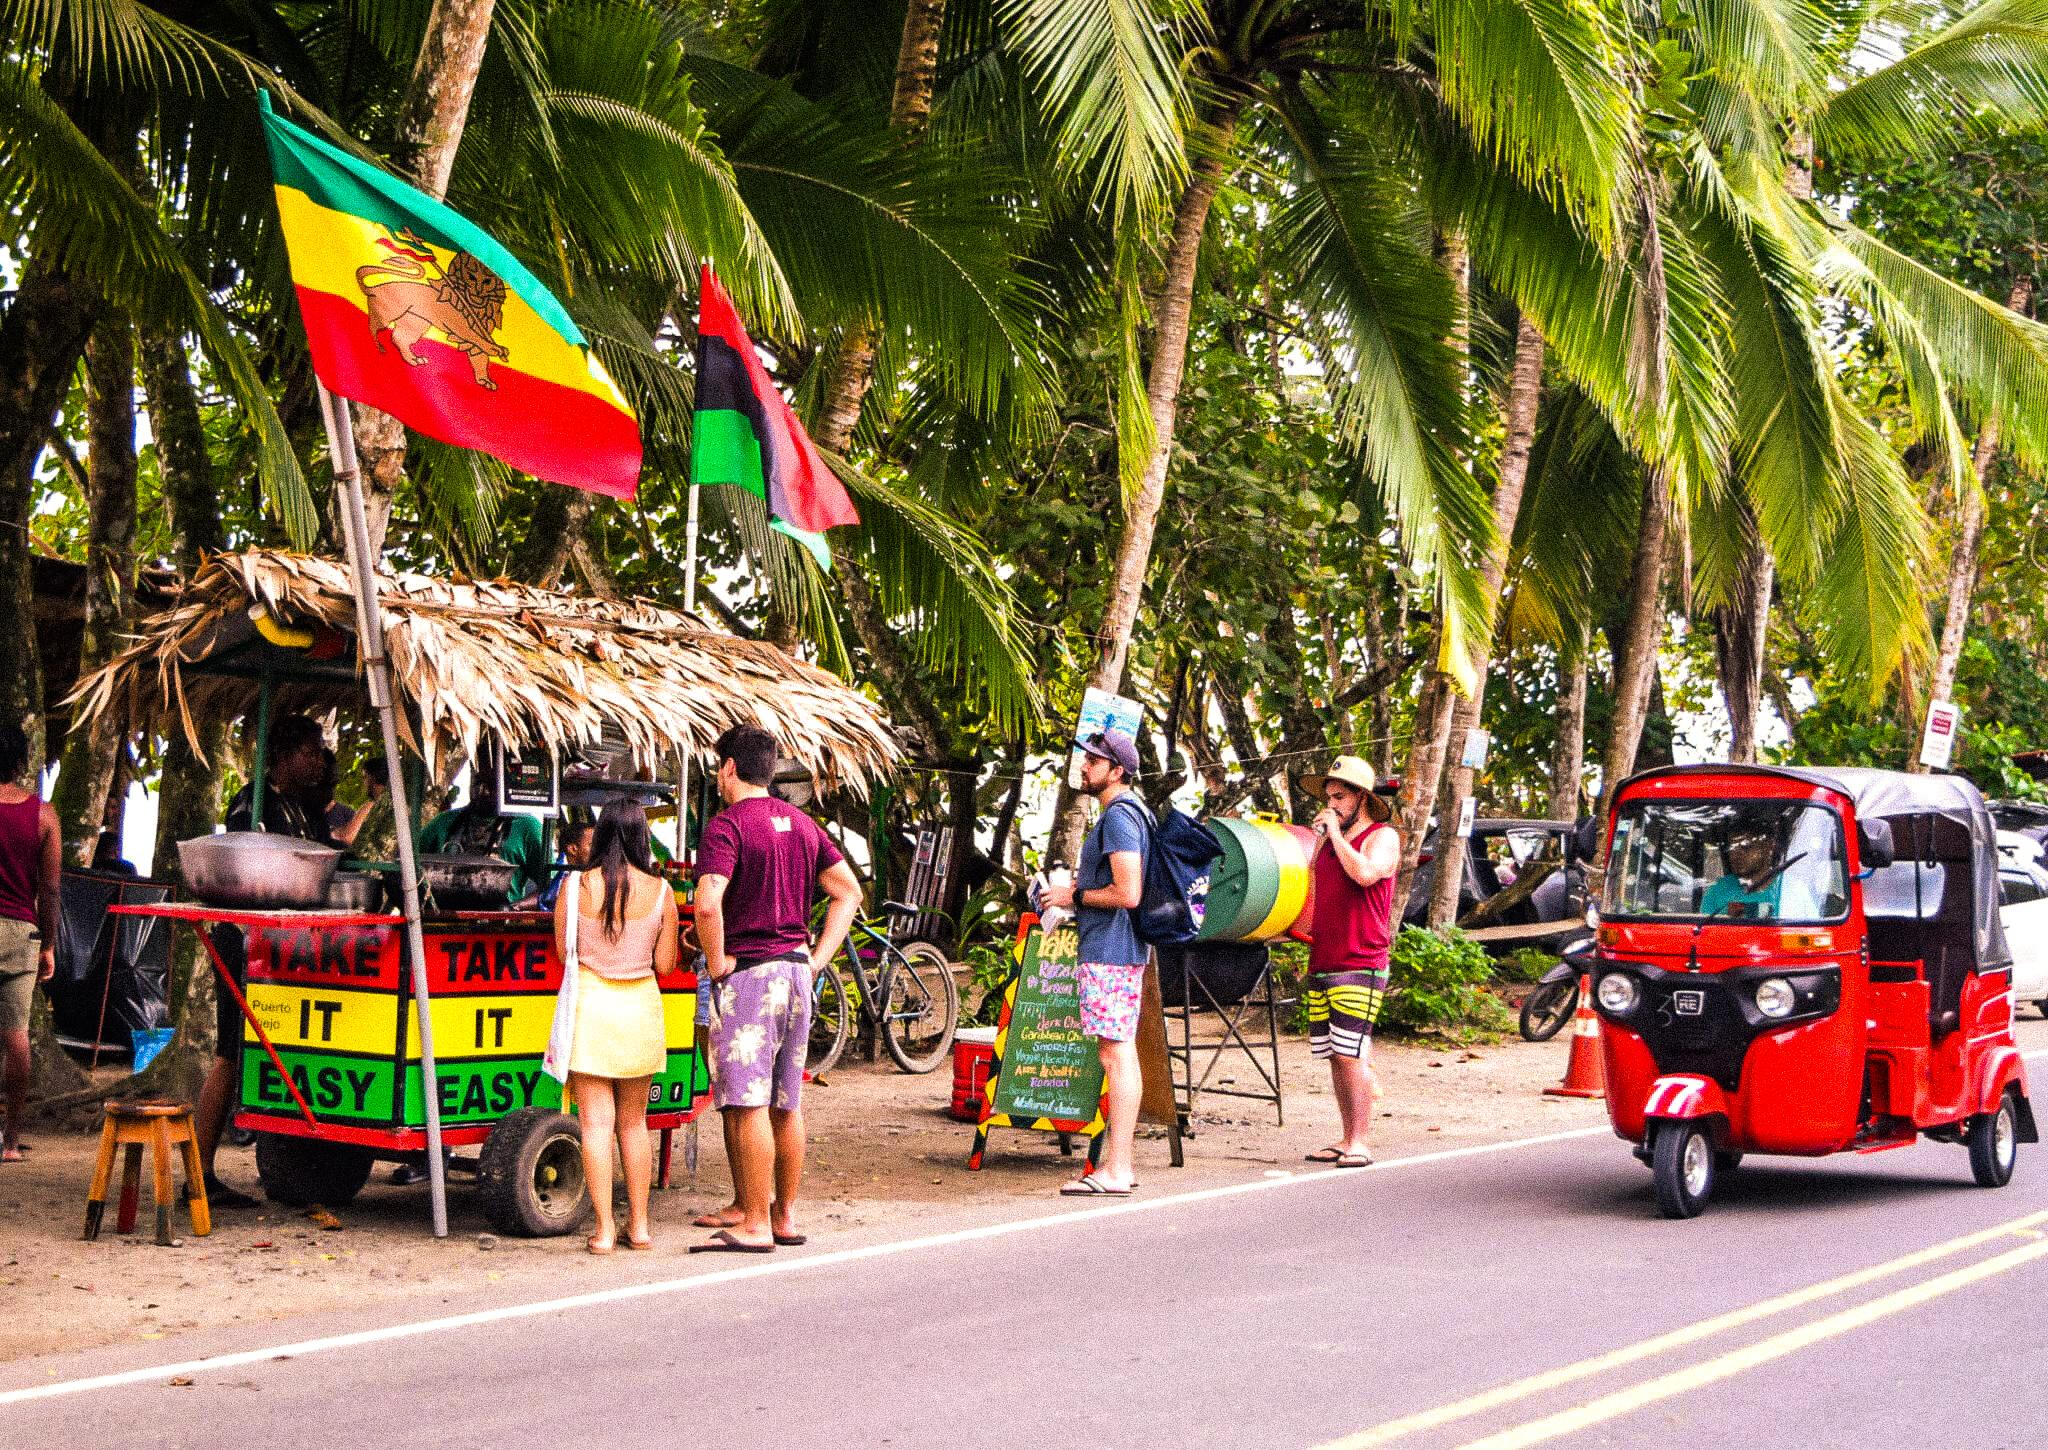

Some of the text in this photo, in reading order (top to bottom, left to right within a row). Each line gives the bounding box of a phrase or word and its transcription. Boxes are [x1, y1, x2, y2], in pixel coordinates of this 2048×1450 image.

[262, 928, 382, 977] TAKE
[441, 941, 547, 982] TAKE
[252, 1000, 291, 1014] Puerto
[255, 1018, 280, 1031] iejo
[300, 999, 342, 1041] IT
[475, 1008, 512, 1048] IT
[258, 1060, 376, 1111] EASY
[437, 1071, 542, 1115] EASY
